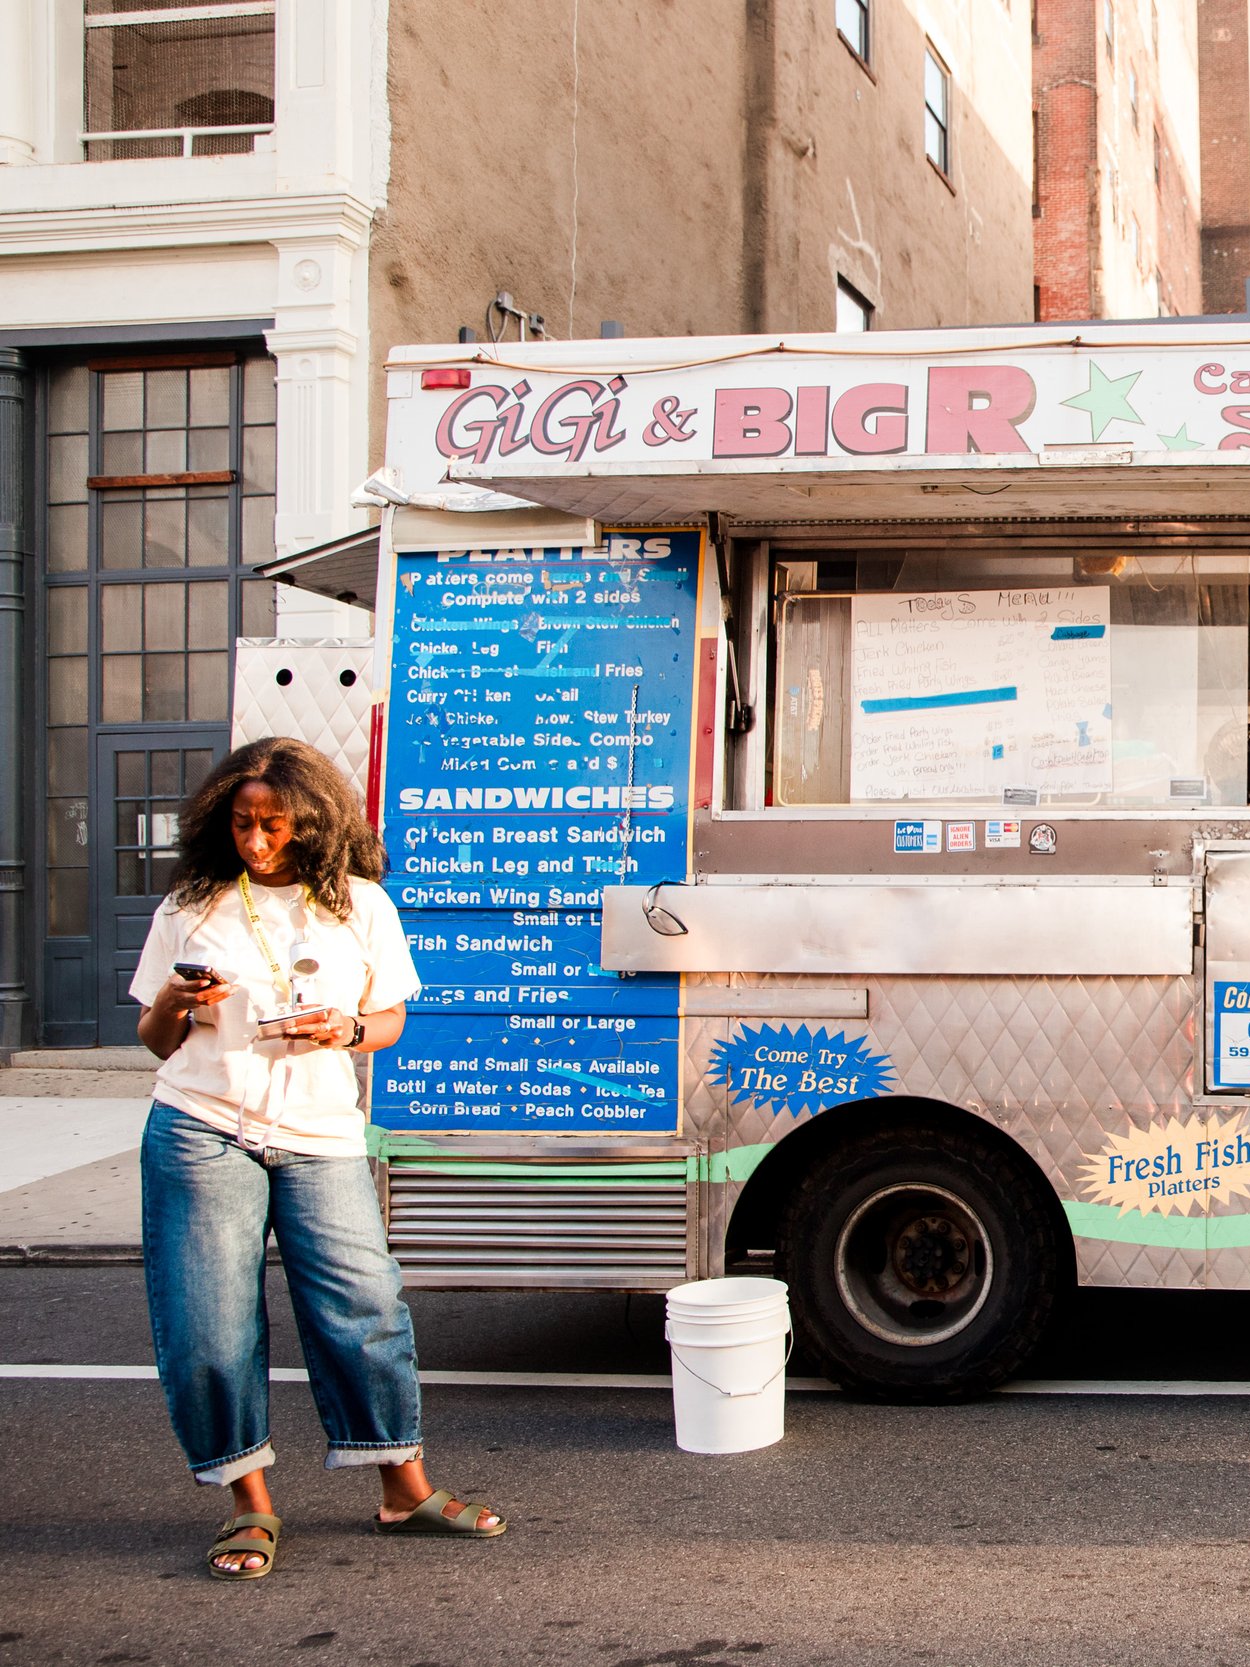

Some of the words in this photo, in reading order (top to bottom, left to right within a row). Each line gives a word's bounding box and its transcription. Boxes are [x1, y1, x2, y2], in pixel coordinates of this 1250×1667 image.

[641, 395, 698, 447] &
[712, 382, 910, 458] BIG
[925, 365, 1037, 455] R
[410, 571, 478, 586] Patters
[485, 572, 534, 584] come
[442, 592, 524, 608] Complete
[575, 591, 586, 604] 2
[594, 589, 641, 604] sides
[410, 642, 462, 655] Chicke
[605, 664, 643, 677] Fries
[406, 690, 447, 705] Curry
[446, 711, 500, 725] Chicke
[584, 710, 618, 724] Stew
[624, 709, 671, 726] Turkey
[590, 732, 654, 746] Combo
[399, 786, 674, 811] SANDWICHES
[492, 826, 558, 844] Breast
[567, 825, 666, 843] Sandwich
[405, 856, 484, 874] Chicken
[492, 856, 529, 875] Leg
[537, 856, 574, 873] and
[582, 856, 638, 875] Thigh
[401, 886, 480, 905] Chicken
[490, 888, 540, 908] Wing
[549, 887, 604, 905] Sand
[513, 912, 558, 927] Small
[565, 914, 583, 927] or
[405, 934, 447, 951] Fish
[455, 934, 553, 951] Sandwich
[511, 962, 556, 977] Small
[563, 964, 581, 977] or
[474, 987, 509, 1003] and
[518, 987, 569, 1003] Fries
[509, 1015, 555, 1030] Small
[562, 1017, 580, 1030] or
[587, 1015, 636, 1032] Large
[397, 1056, 442, 1072] Large
[449, 1057, 478, 1070] and
[485, 1057, 528, 1071] Small
[537, 1058, 582, 1073] Sides
[589, 1060, 660, 1074] Available
[754, 1046, 809, 1064] Come
[818, 1049, 848, 1069] Try
[387, 1078, 446, 1094] Bottld
[453, 1080, 498, 1095] Water
[519, 1081, 571, 1097] Sodas
[638, 1084, 666, 1098] Tea
[740, 1067, 788, 1091] The
[798, 1070, 860, 1095] Best
[409, 1100, 448, 1116] Corn
[525, 1103, 575, 1118] Peach
[581, 1104, 647, 1119] Cobbler
[1108, 1144, 1182, 1184] Fresh
[1148, 1176, 1221, 1198] Platters
